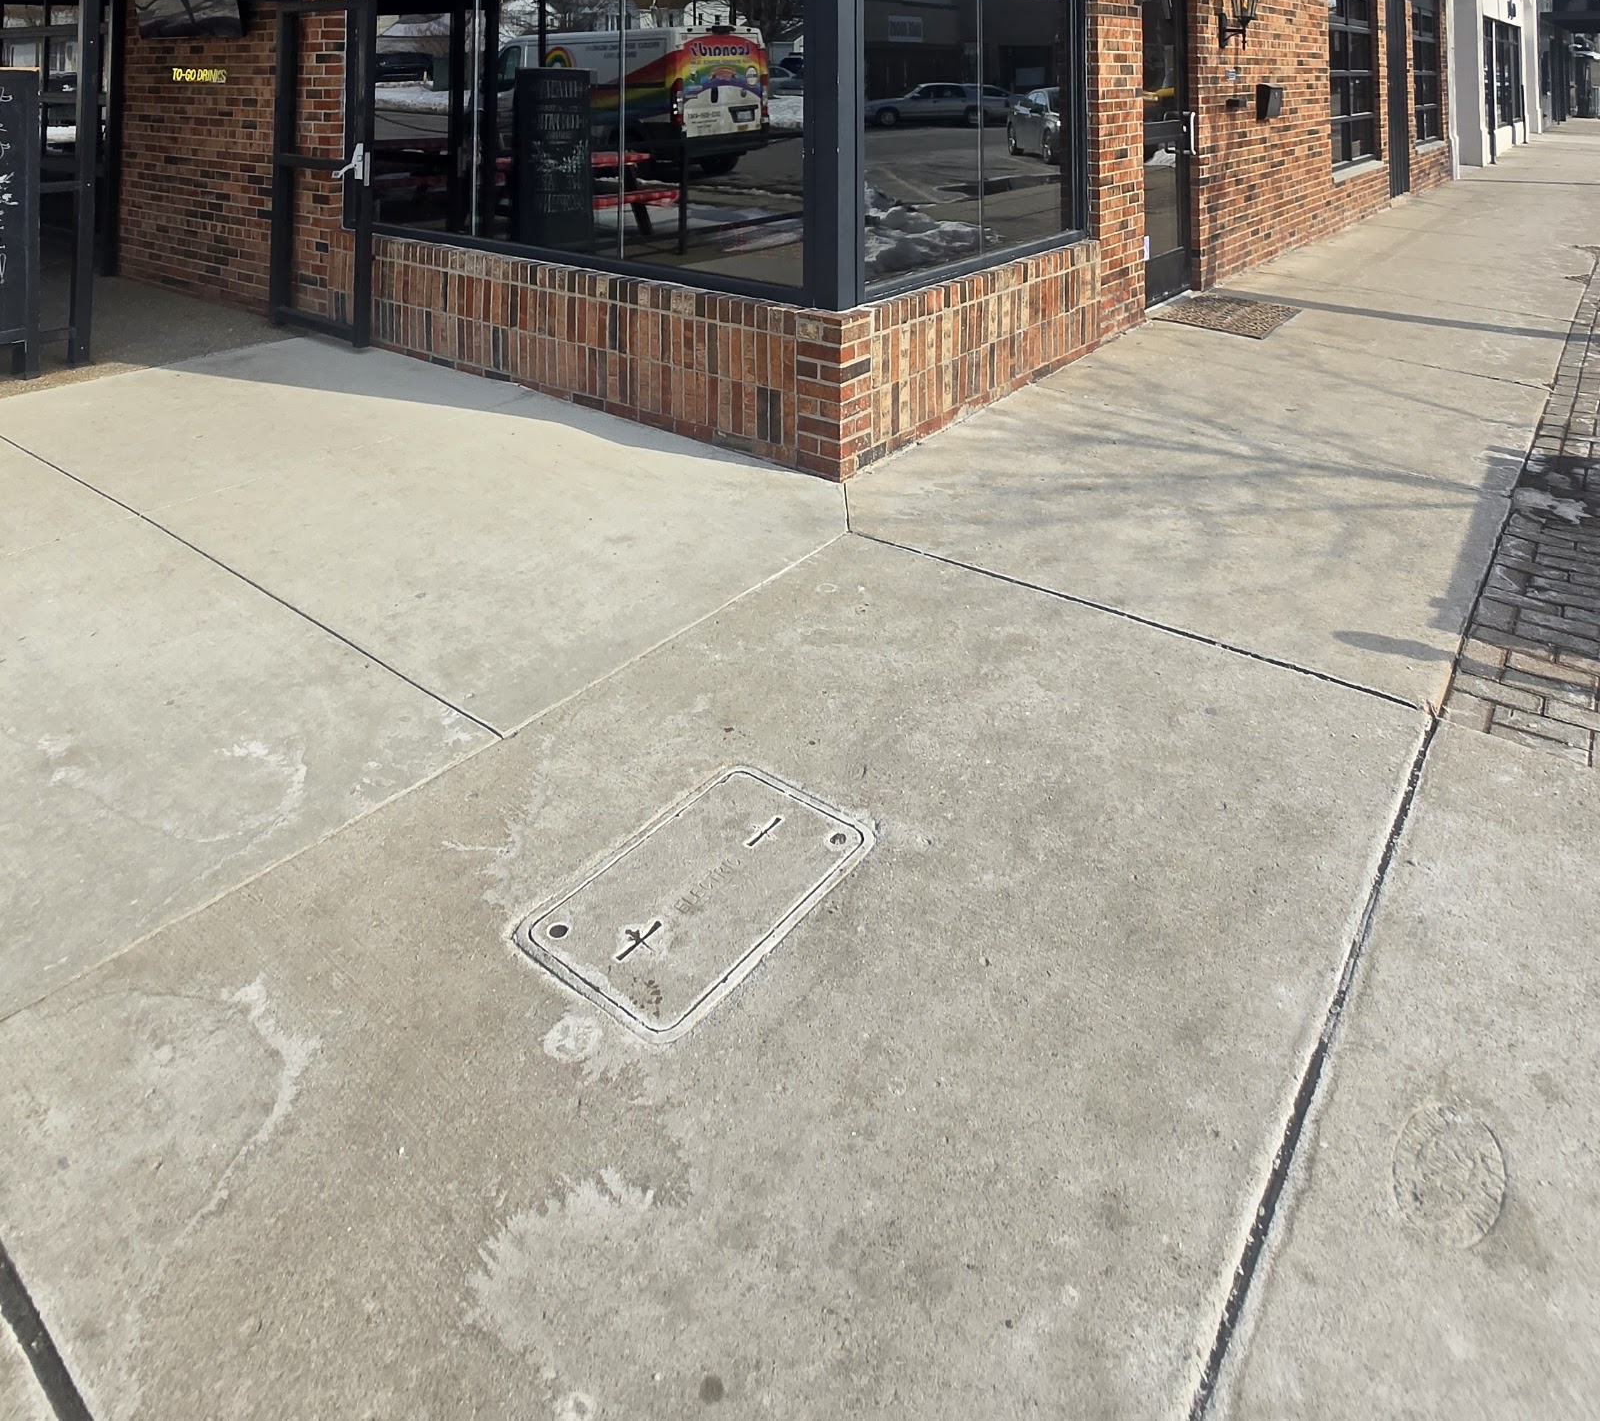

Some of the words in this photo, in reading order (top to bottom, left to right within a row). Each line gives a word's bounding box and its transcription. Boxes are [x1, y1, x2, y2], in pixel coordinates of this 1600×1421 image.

[172, 67, 197, 82] TO-GO
[196, 68, 228, 84] DRINKS
[674, 858, 741, 914] ELECTRIC
